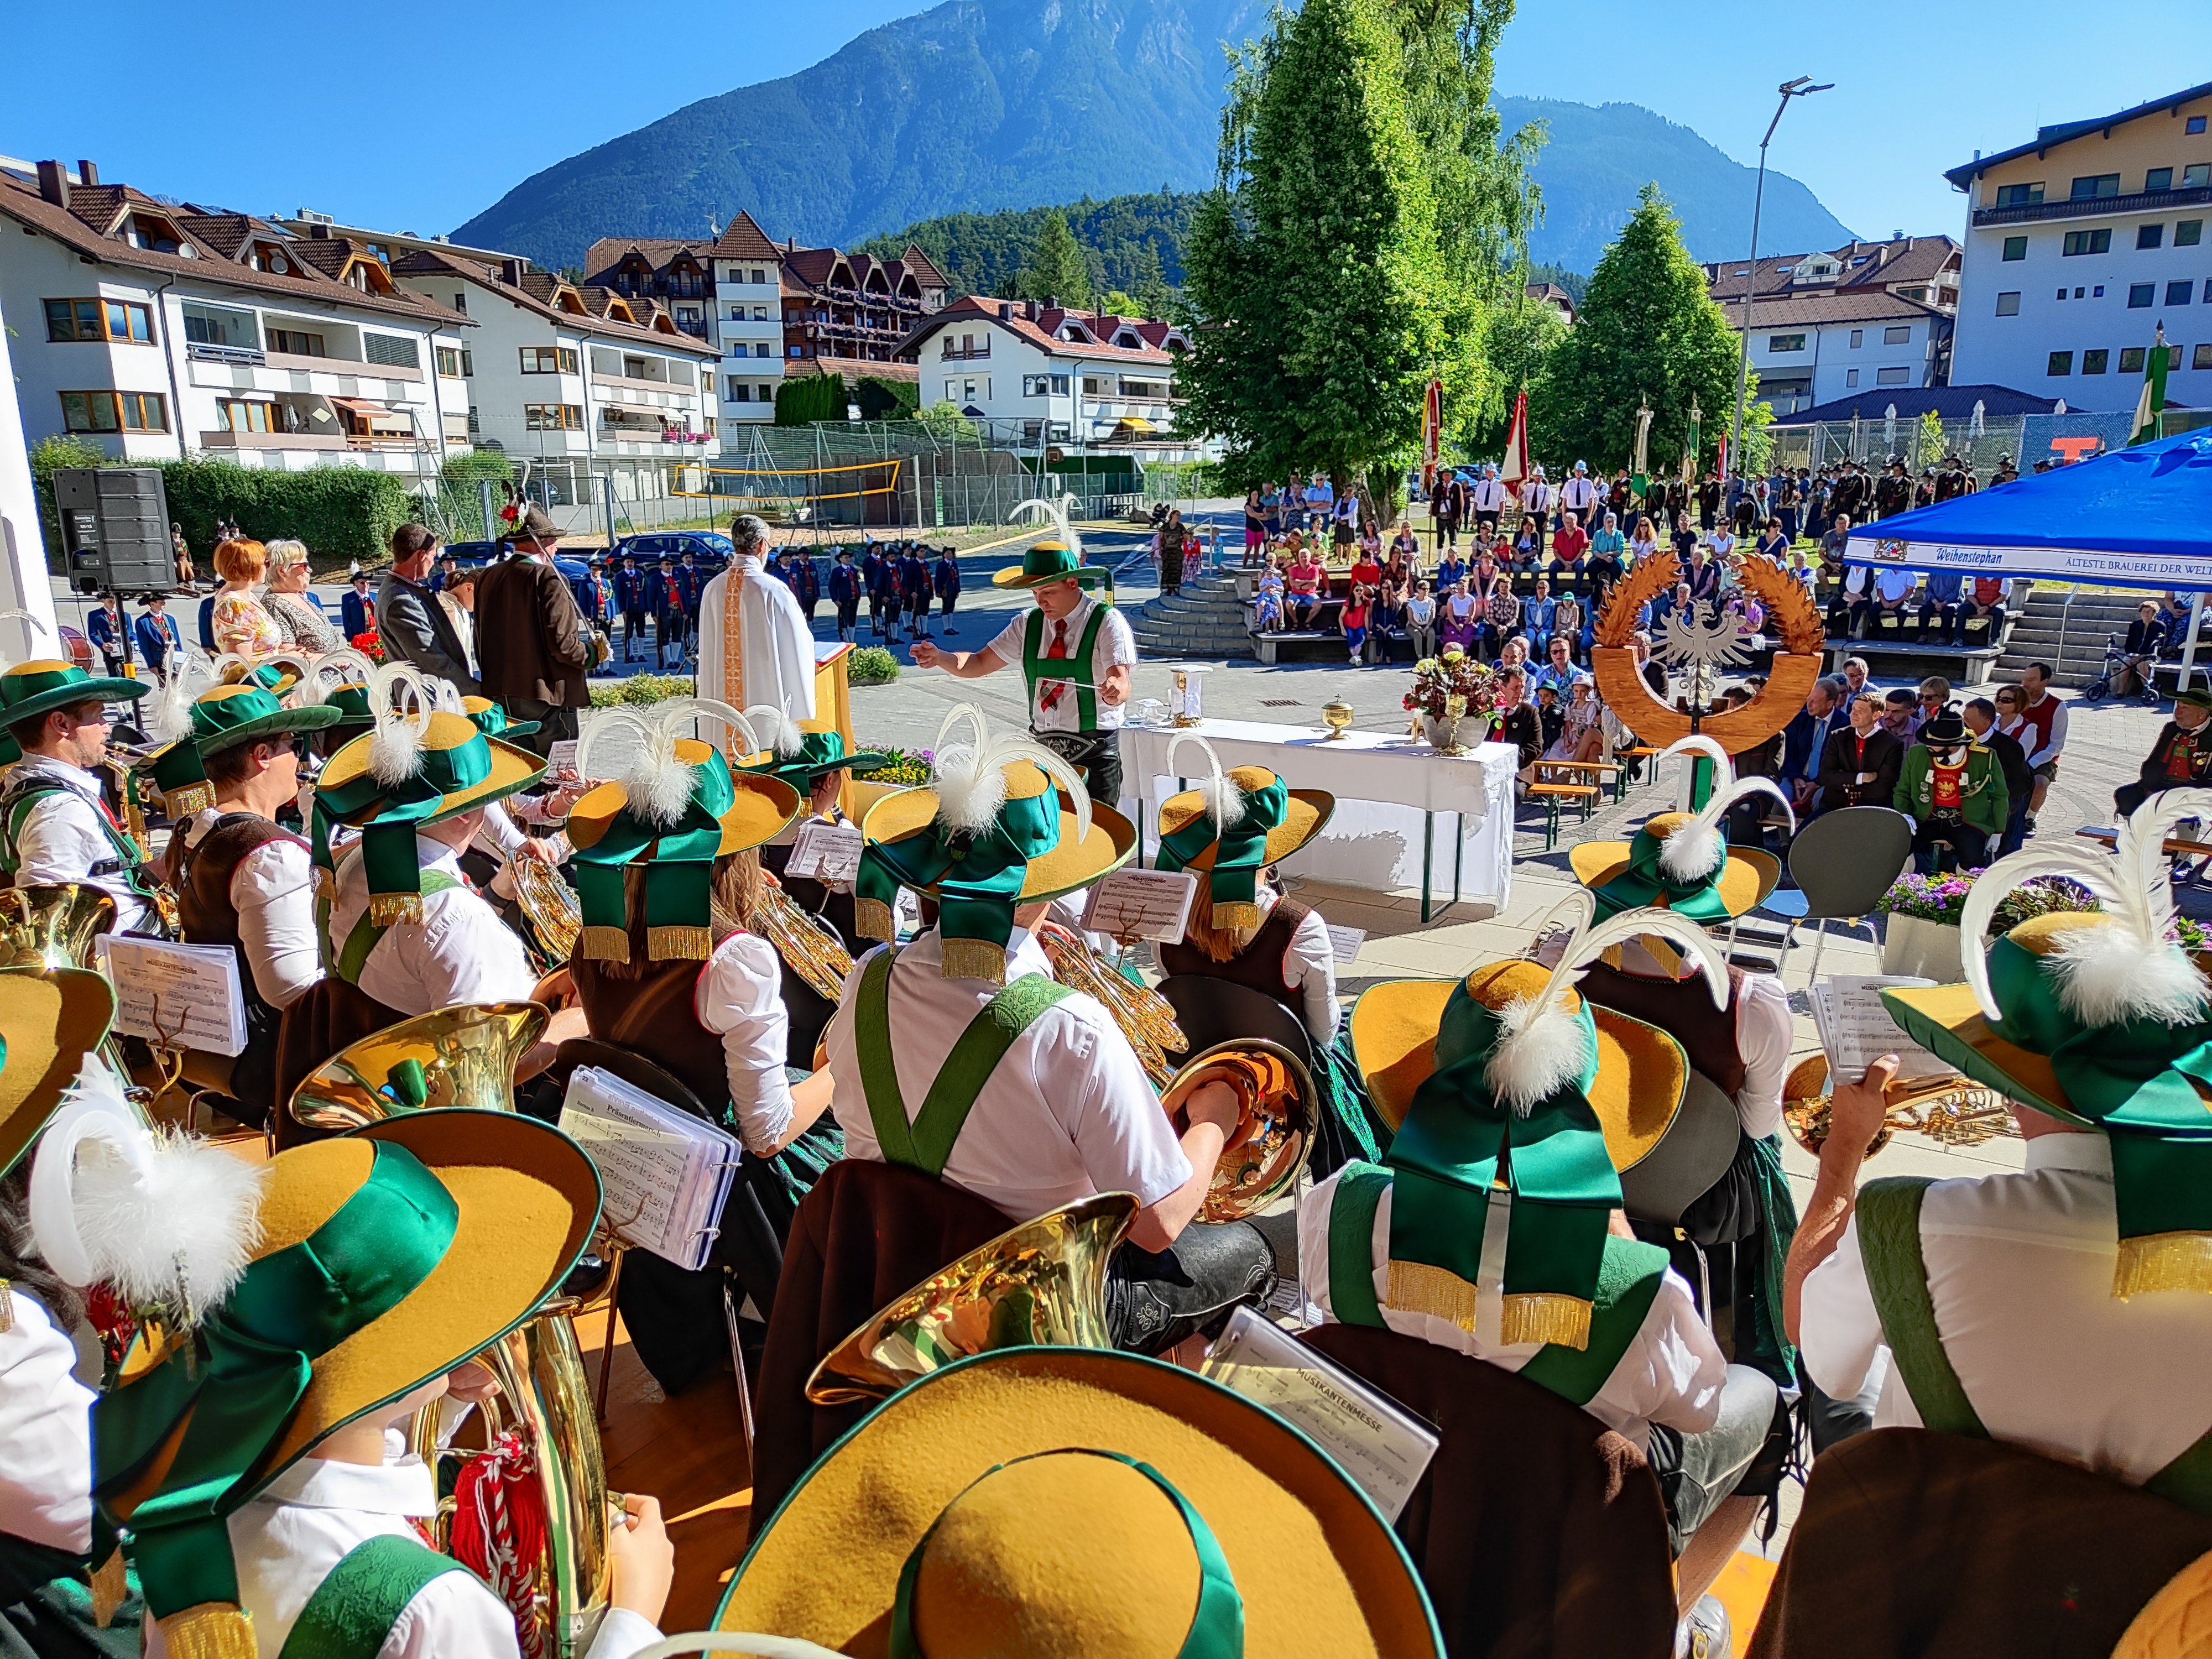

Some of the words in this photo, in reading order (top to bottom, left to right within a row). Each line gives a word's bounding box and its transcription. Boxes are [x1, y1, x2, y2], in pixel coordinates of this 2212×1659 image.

[1936, 547, 2002, 566] Weihenstephan
[2065, 556, 2106, 569] ÄLTESTE
[2108, 561, 2158, 572] BRAUEREI
[2159, 564, 2182, 573] DER
[2184, 565, 2212, 575] WELT
[607, 1104, 661, 1138] Präsentiermarsch
[1296, 1368, 1383, 1433] MUSIKANTENMESSE
